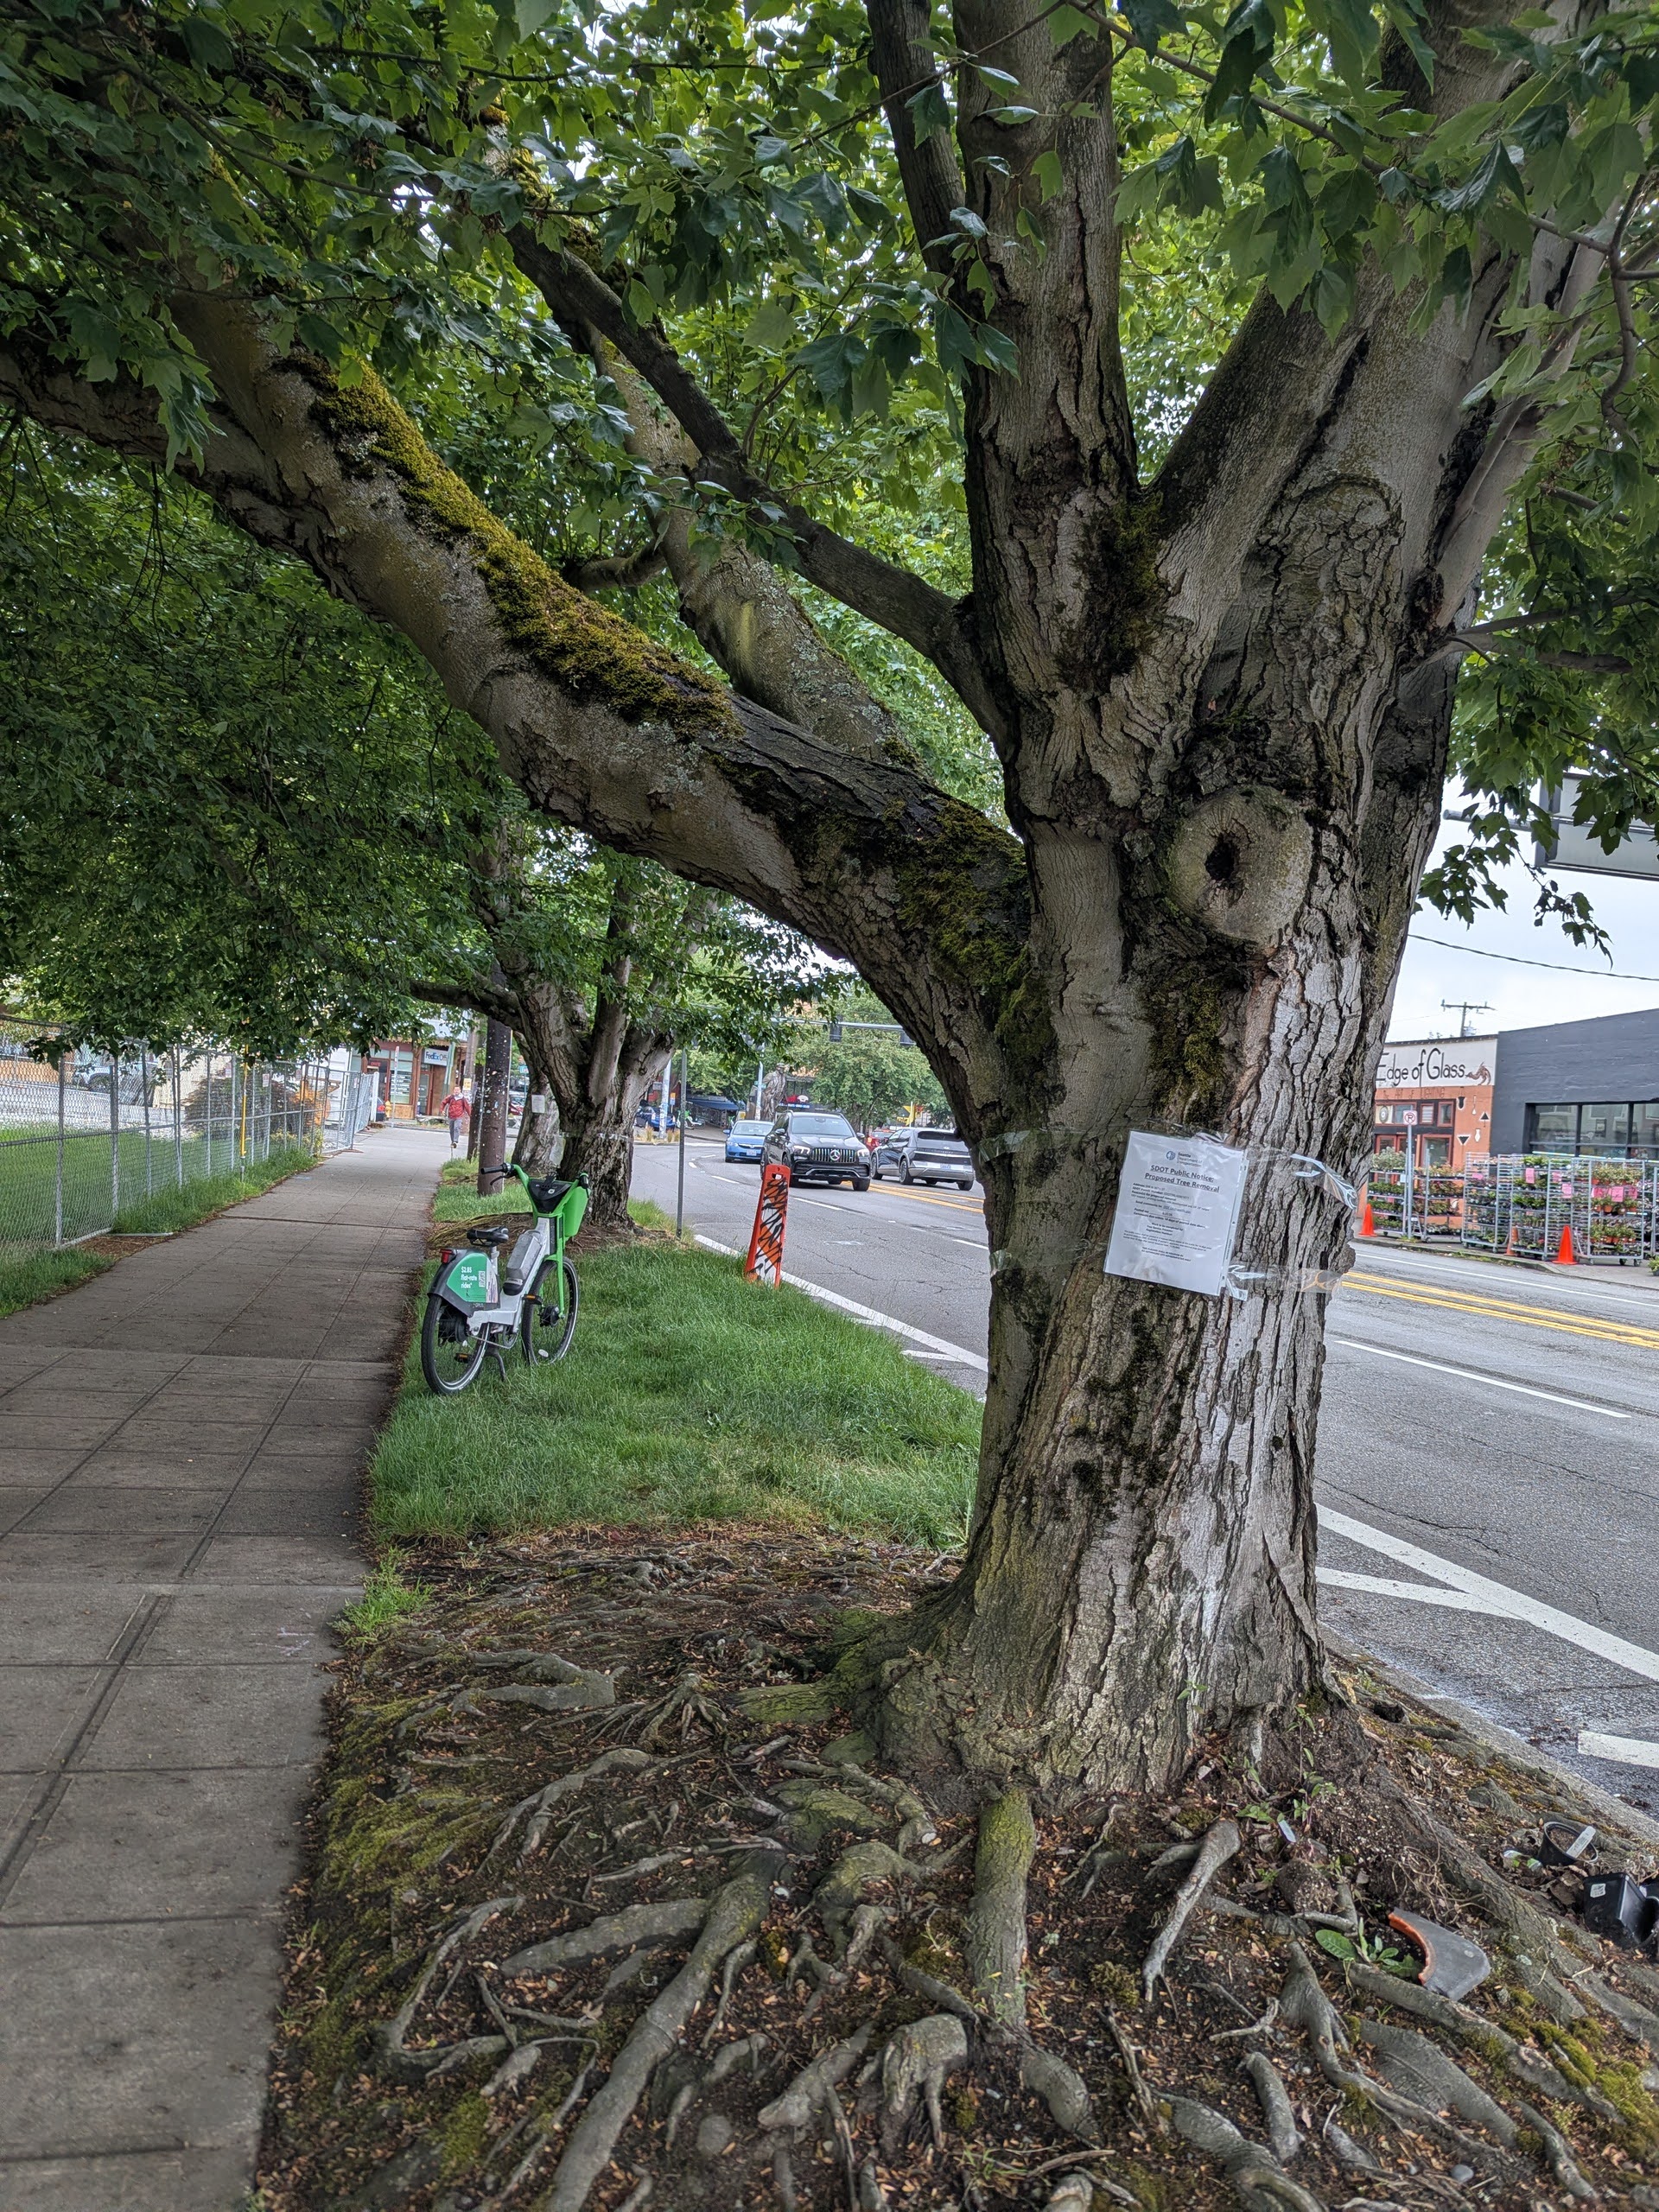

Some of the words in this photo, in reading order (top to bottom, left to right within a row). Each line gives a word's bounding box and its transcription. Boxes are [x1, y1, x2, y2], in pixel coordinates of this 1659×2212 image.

[425, 1051, 440, 1060] FedEx
[1376, 1052, 1409, 1087] Edge
[1412, 1049, 1427, 1088] of
[1427, 1047, 1466, 1080] Glass
[1150, 1165, 1170, 1173] SDOT
[1170, 1168, 1191, 1179] Public
[1144, 1173, 1175, 1184] Proposed
[1176, 1178, 1191, 1187] Tree
[1192, 1181, 1220, 1192] Removal
